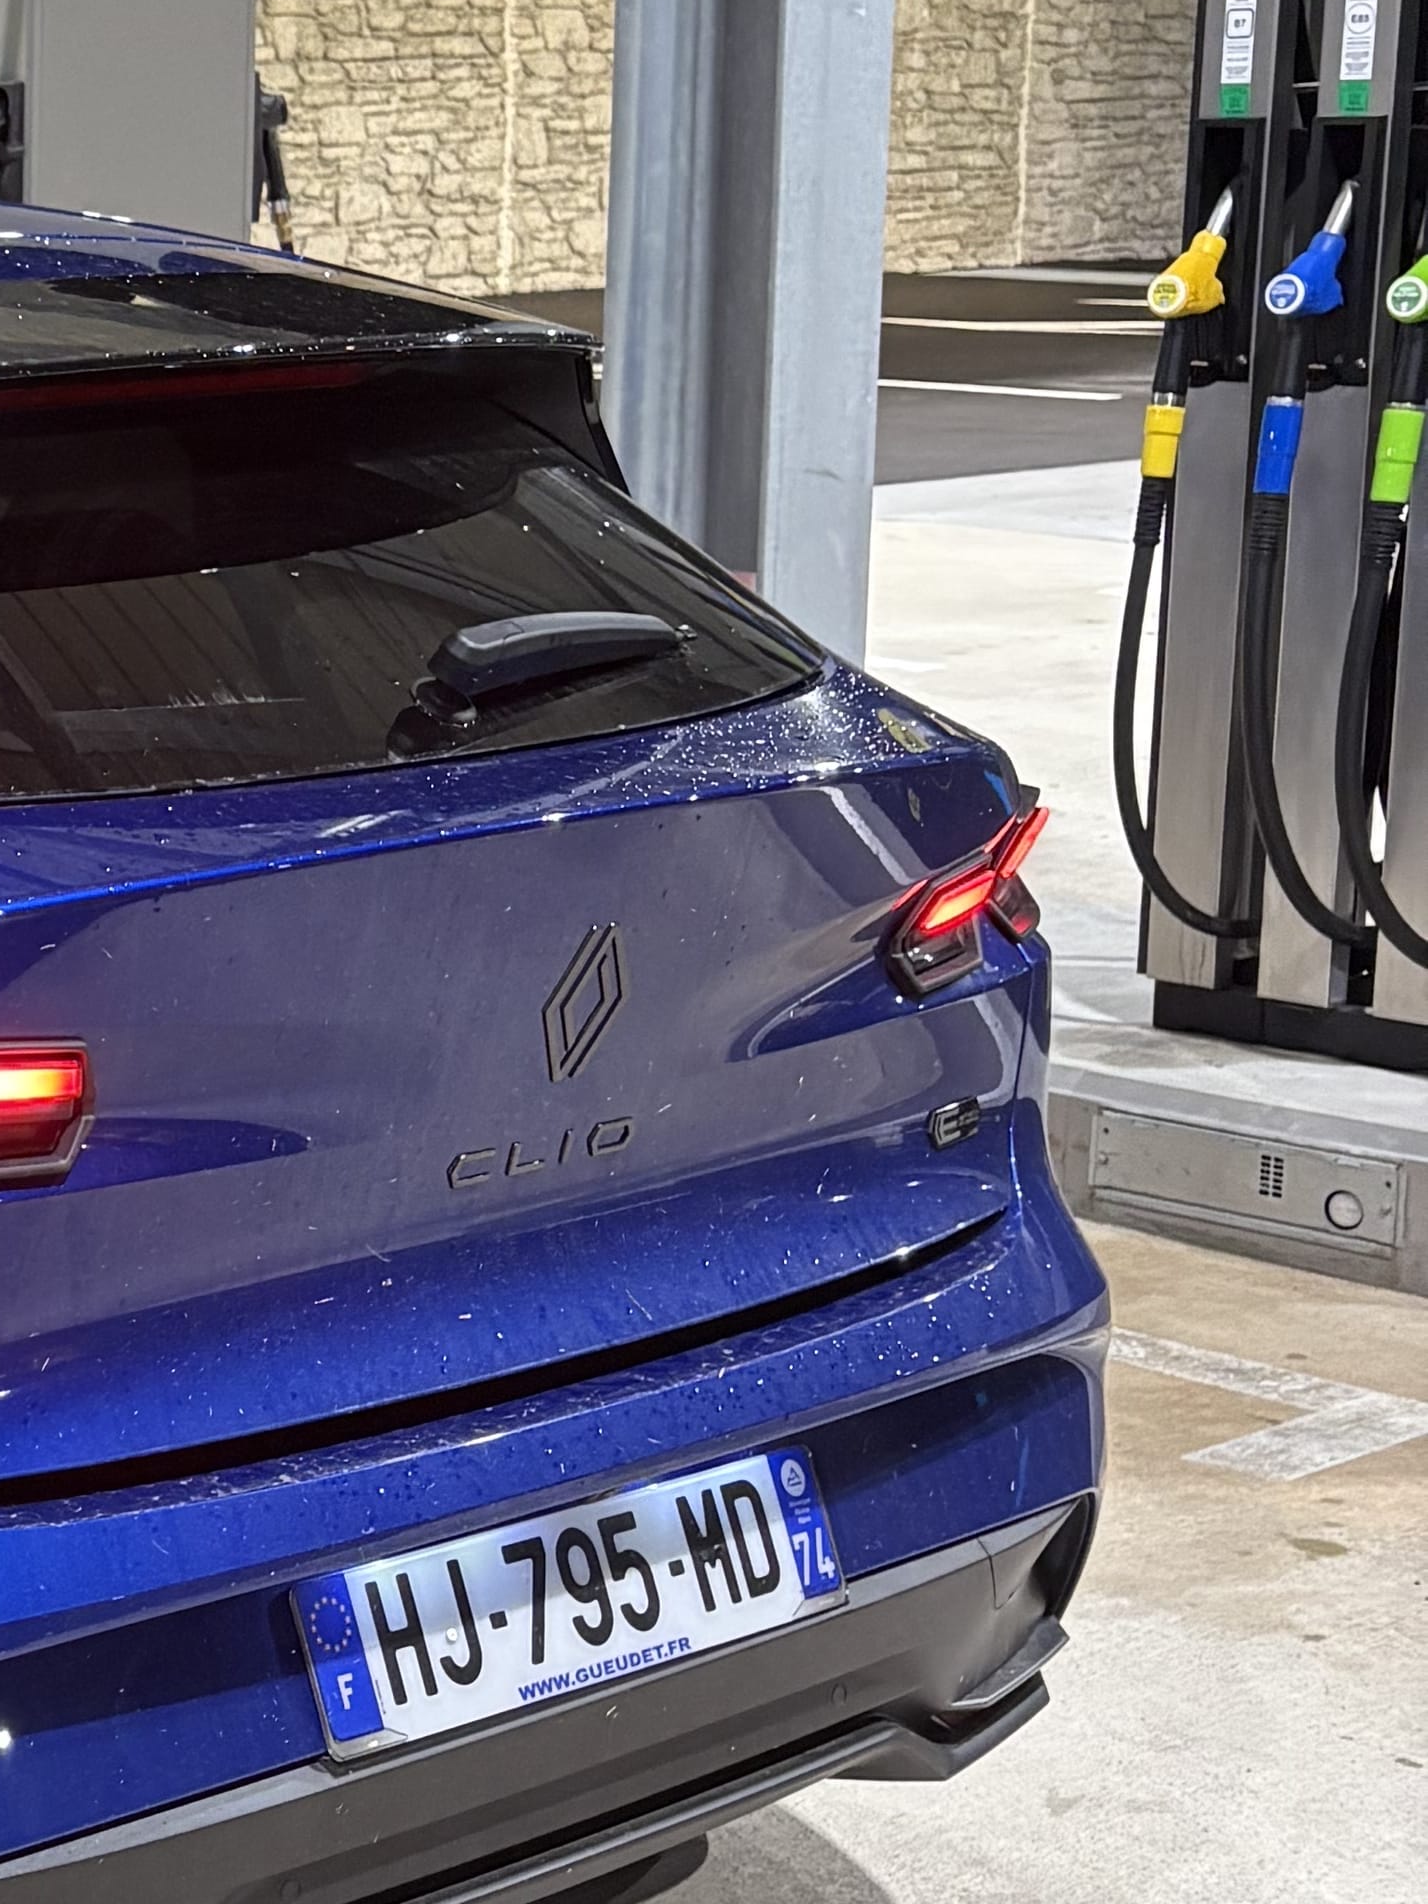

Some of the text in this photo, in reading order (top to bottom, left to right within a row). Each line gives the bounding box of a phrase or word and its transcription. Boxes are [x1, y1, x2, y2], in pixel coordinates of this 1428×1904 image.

[446, 1114, 635, 1191] CLIO
[791, 1527, 836, 1586] 74
[364, 1478, 782, 1706] HJ-795-MD
[337, 1672, 353, 1710] F
[517, 1636, 693, 1702] WWW.GUEUDET.FR
